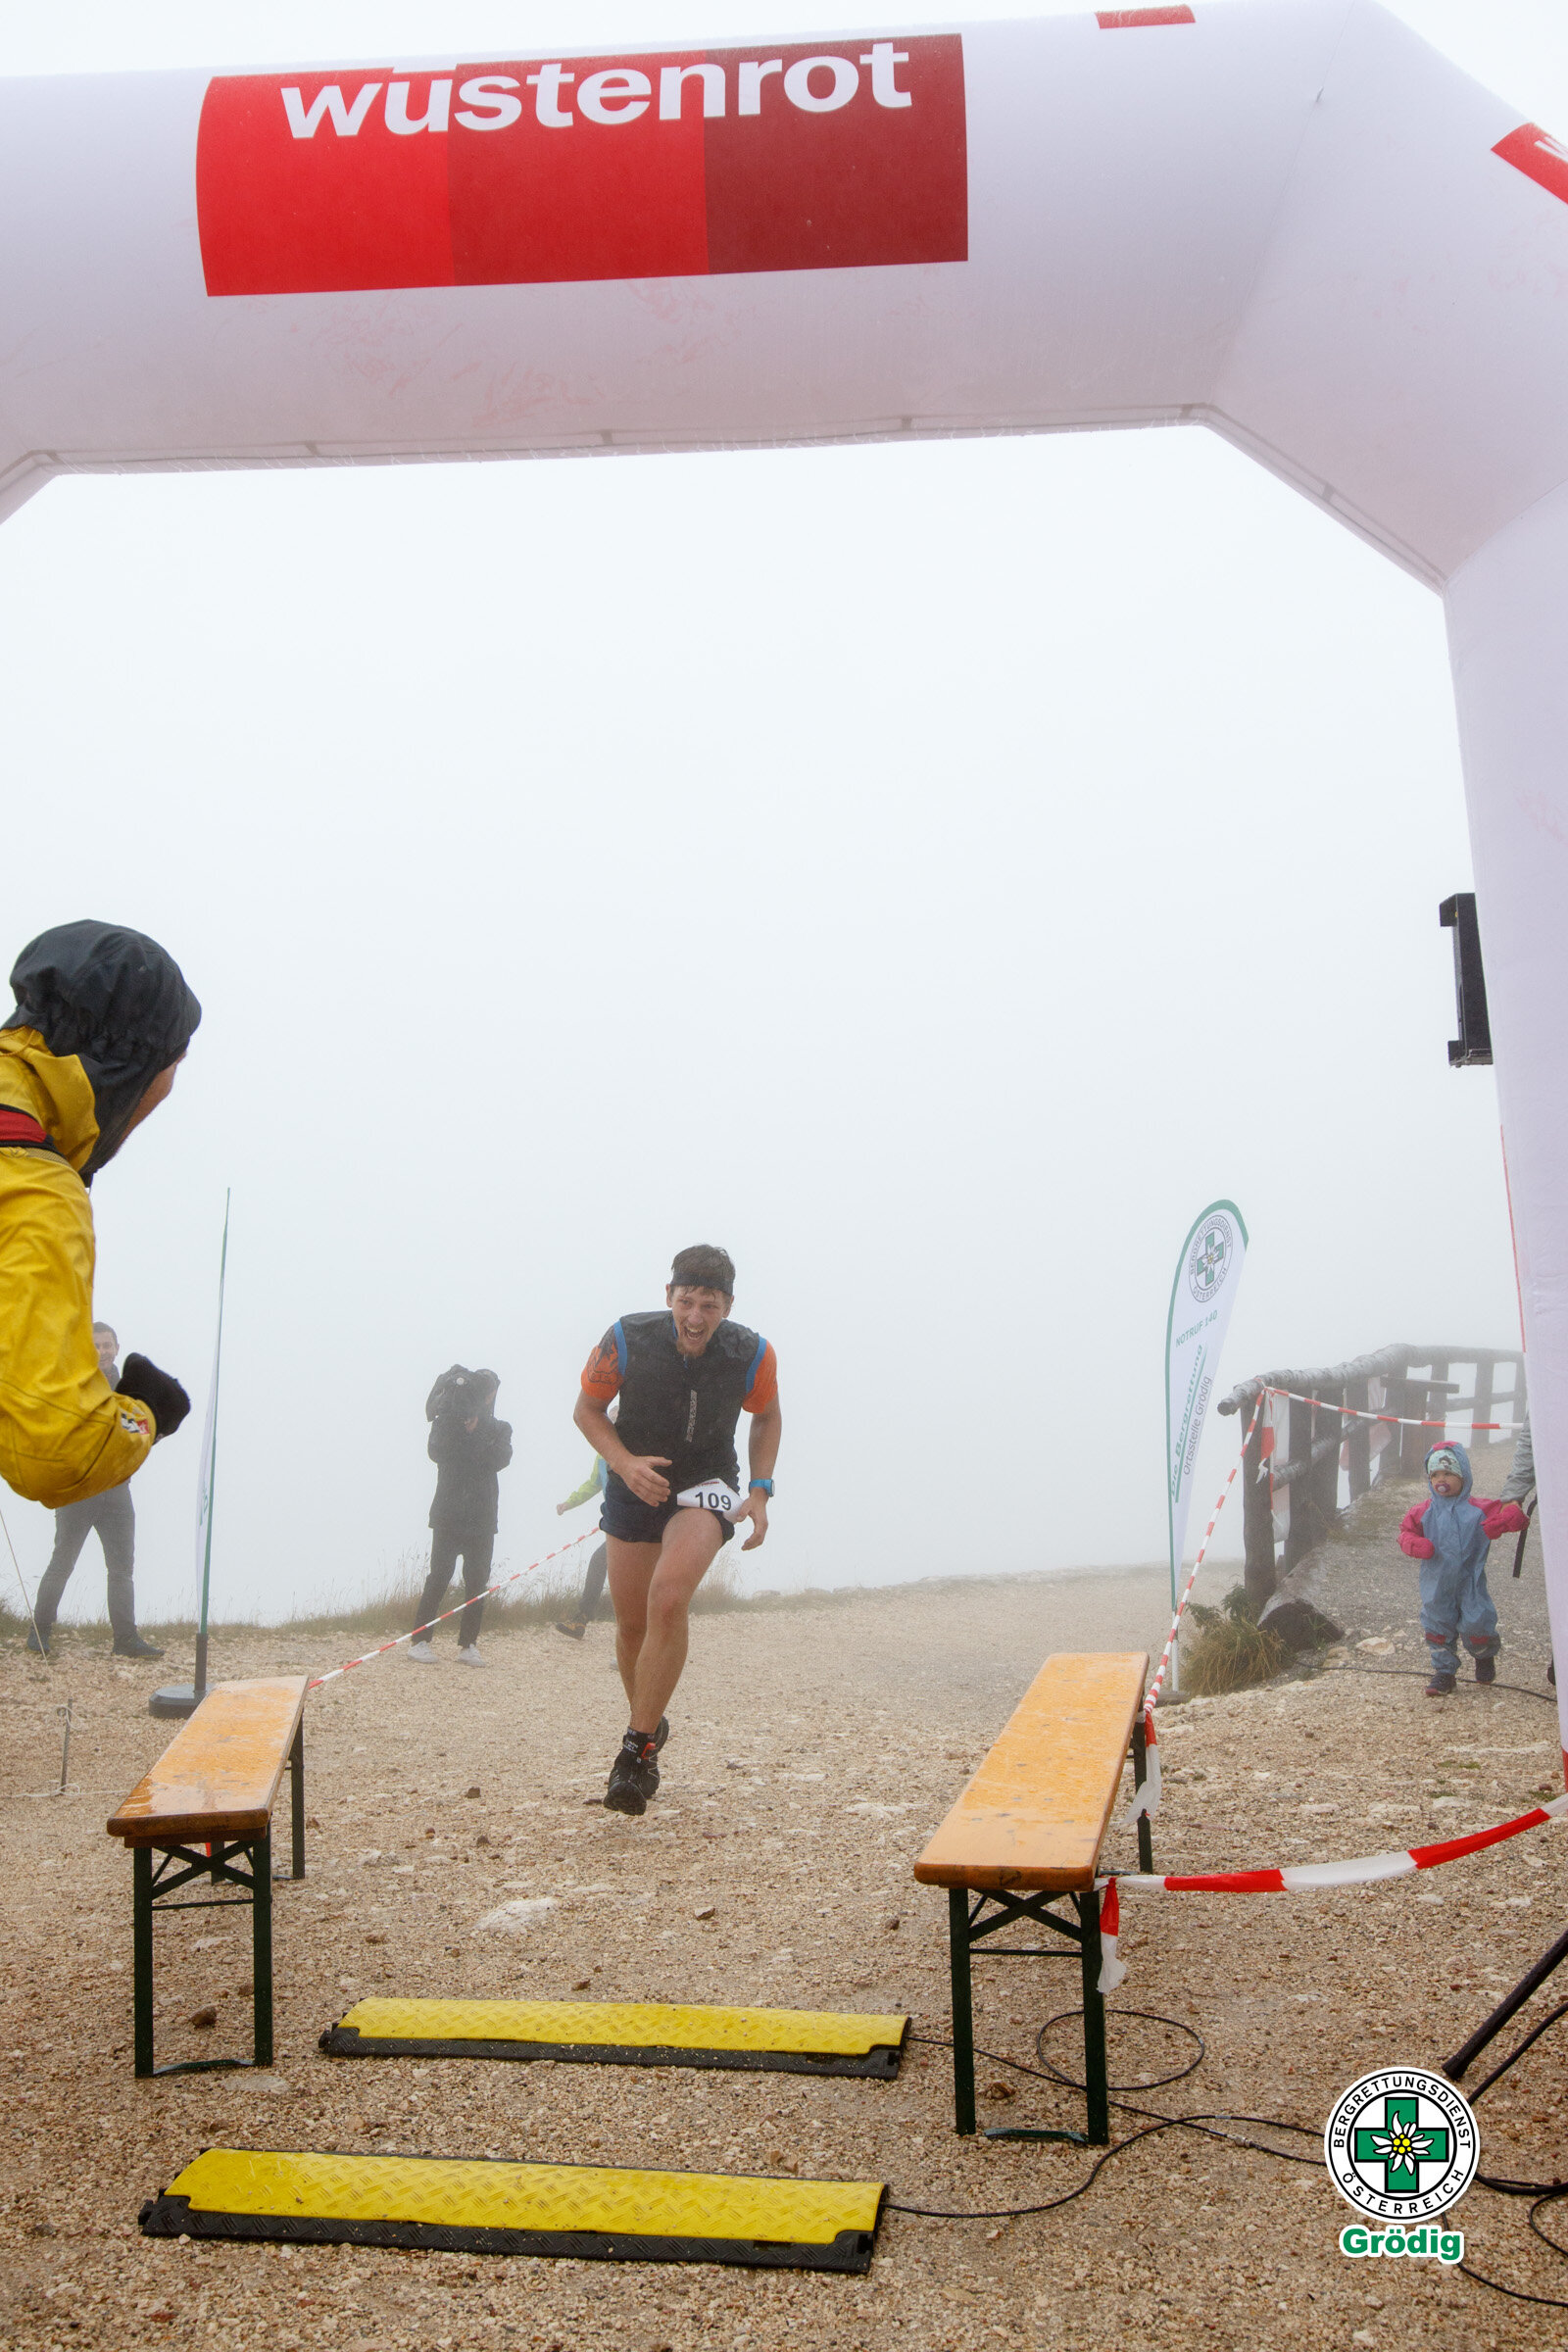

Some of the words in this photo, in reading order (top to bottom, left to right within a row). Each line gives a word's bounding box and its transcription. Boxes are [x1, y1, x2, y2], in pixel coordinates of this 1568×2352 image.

[1176, 1321, 1203, 1348] NOTRUF
[1204, 1309, 1218, 1327] 140
[1183, 1418, 1201, 1475] Ortsstelle
[695, 1492, 731, 1510] 109
